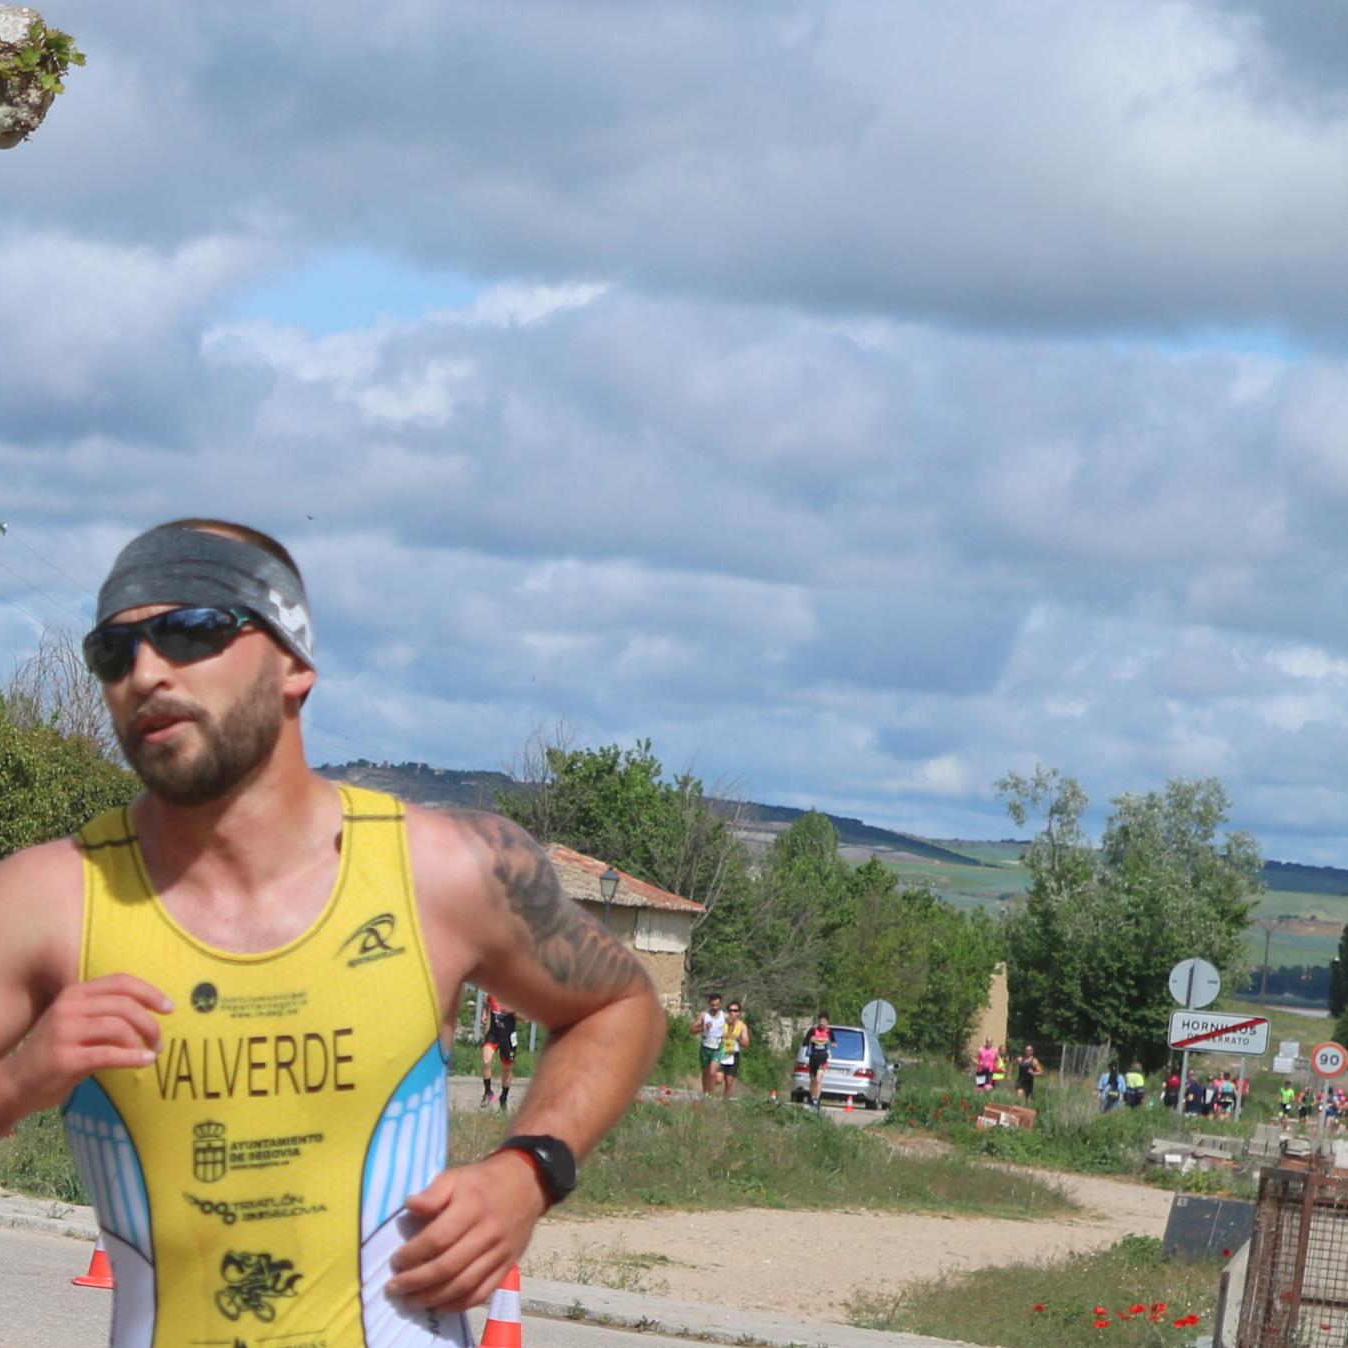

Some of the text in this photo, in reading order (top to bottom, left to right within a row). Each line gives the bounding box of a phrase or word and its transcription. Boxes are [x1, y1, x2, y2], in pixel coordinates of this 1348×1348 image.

[1181, 1020, 1257, 1036] HORNILOS
[153, 1027, 355, 1101] VALVERDE
[1319, 1053, 1340, 1066] 90
[229, 1132, 324, 1152] AYUNTAMIENTO
[229, 1147, 300, 1163] DE SEGOVIA
